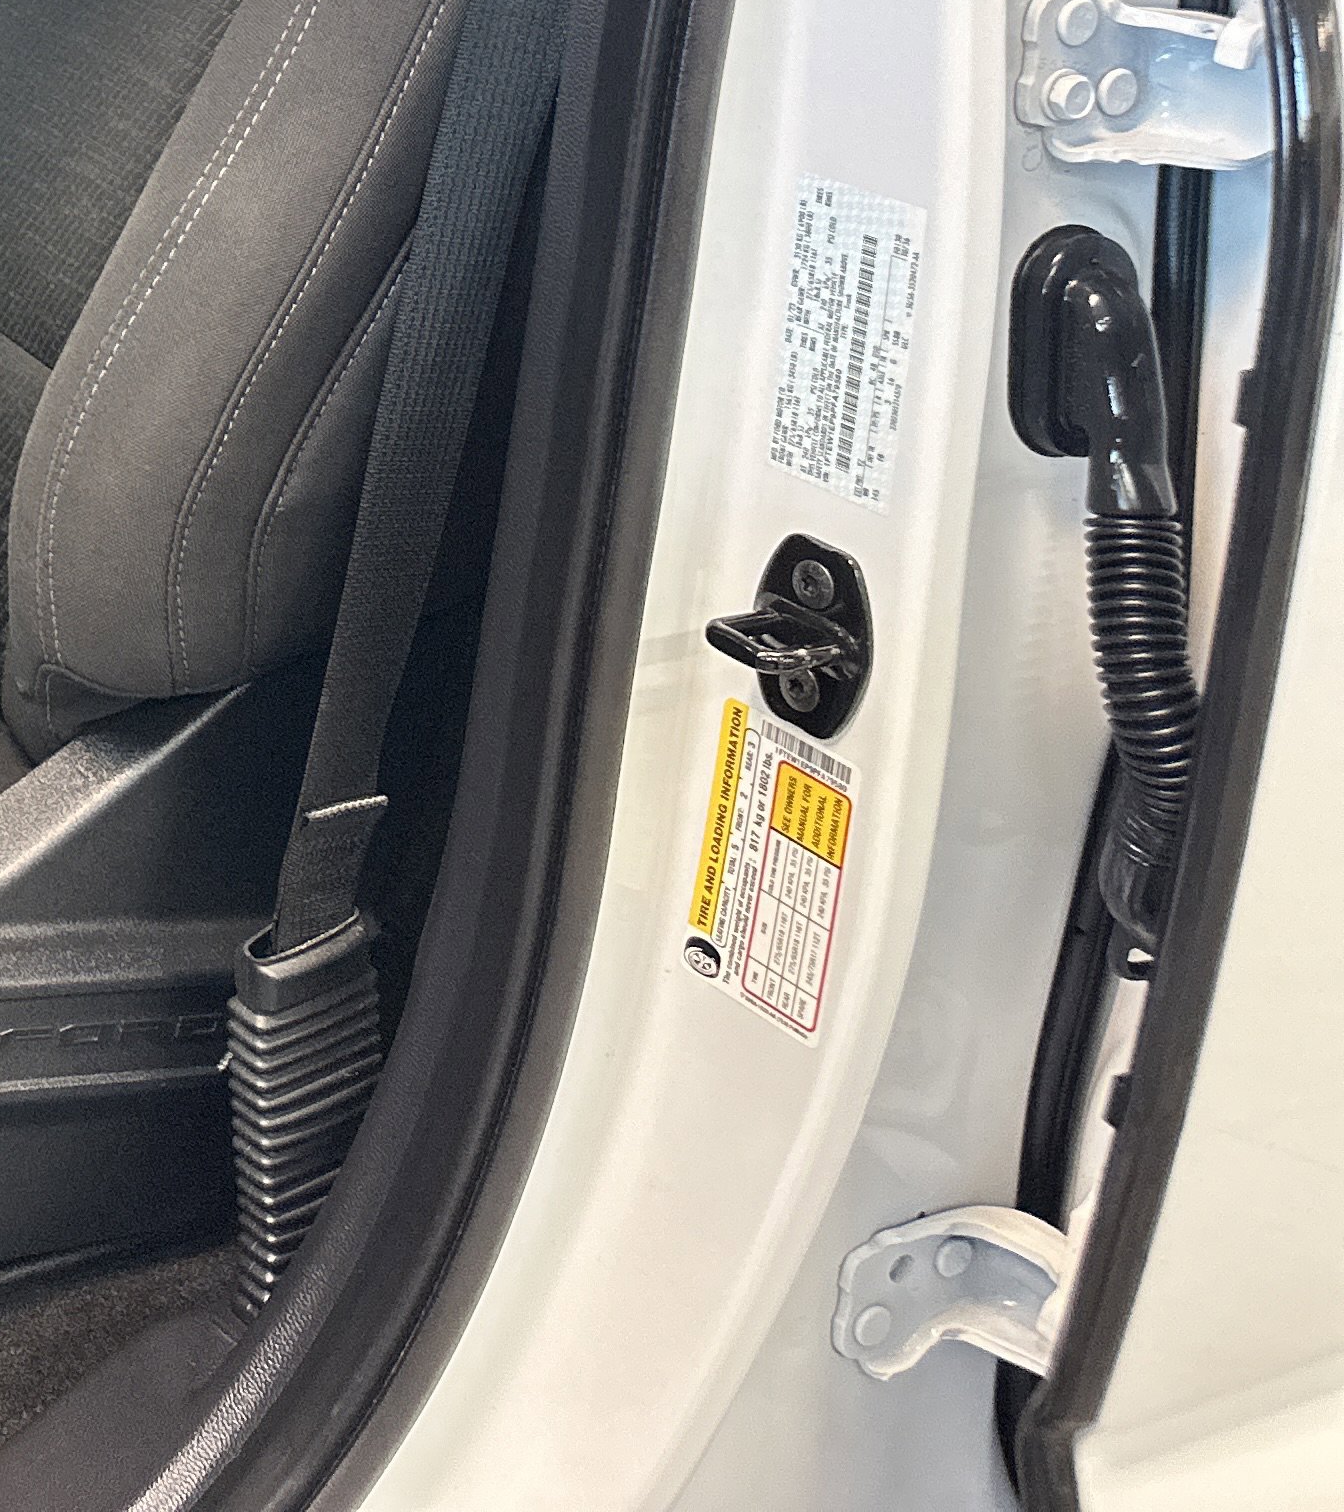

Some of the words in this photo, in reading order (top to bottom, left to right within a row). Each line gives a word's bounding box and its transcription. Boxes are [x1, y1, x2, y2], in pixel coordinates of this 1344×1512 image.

[717, 705, 744, 802] INFORMATION
[739, 790, 748, 800] 2
[747, 739, 756, 750] 3
[757, 768, 771, 798] 1802
[800, 781, 813, 804] FOR
[752, 810, 765, 829] kg
[756, 798, 766, 813] or
[794, 801, 810, 843] MANUAL
[809, 791, 828, 849] ADDITIONAL
[708, 801, 728, 864] LOADING
[747, 828, 761, 853] 817
[779, 813, 791, 834] SEE
[824, 795, 844, 861] INFORMATION
[702, 863, 717, 895] AND
[696, 893, 711, 929] TIRE
